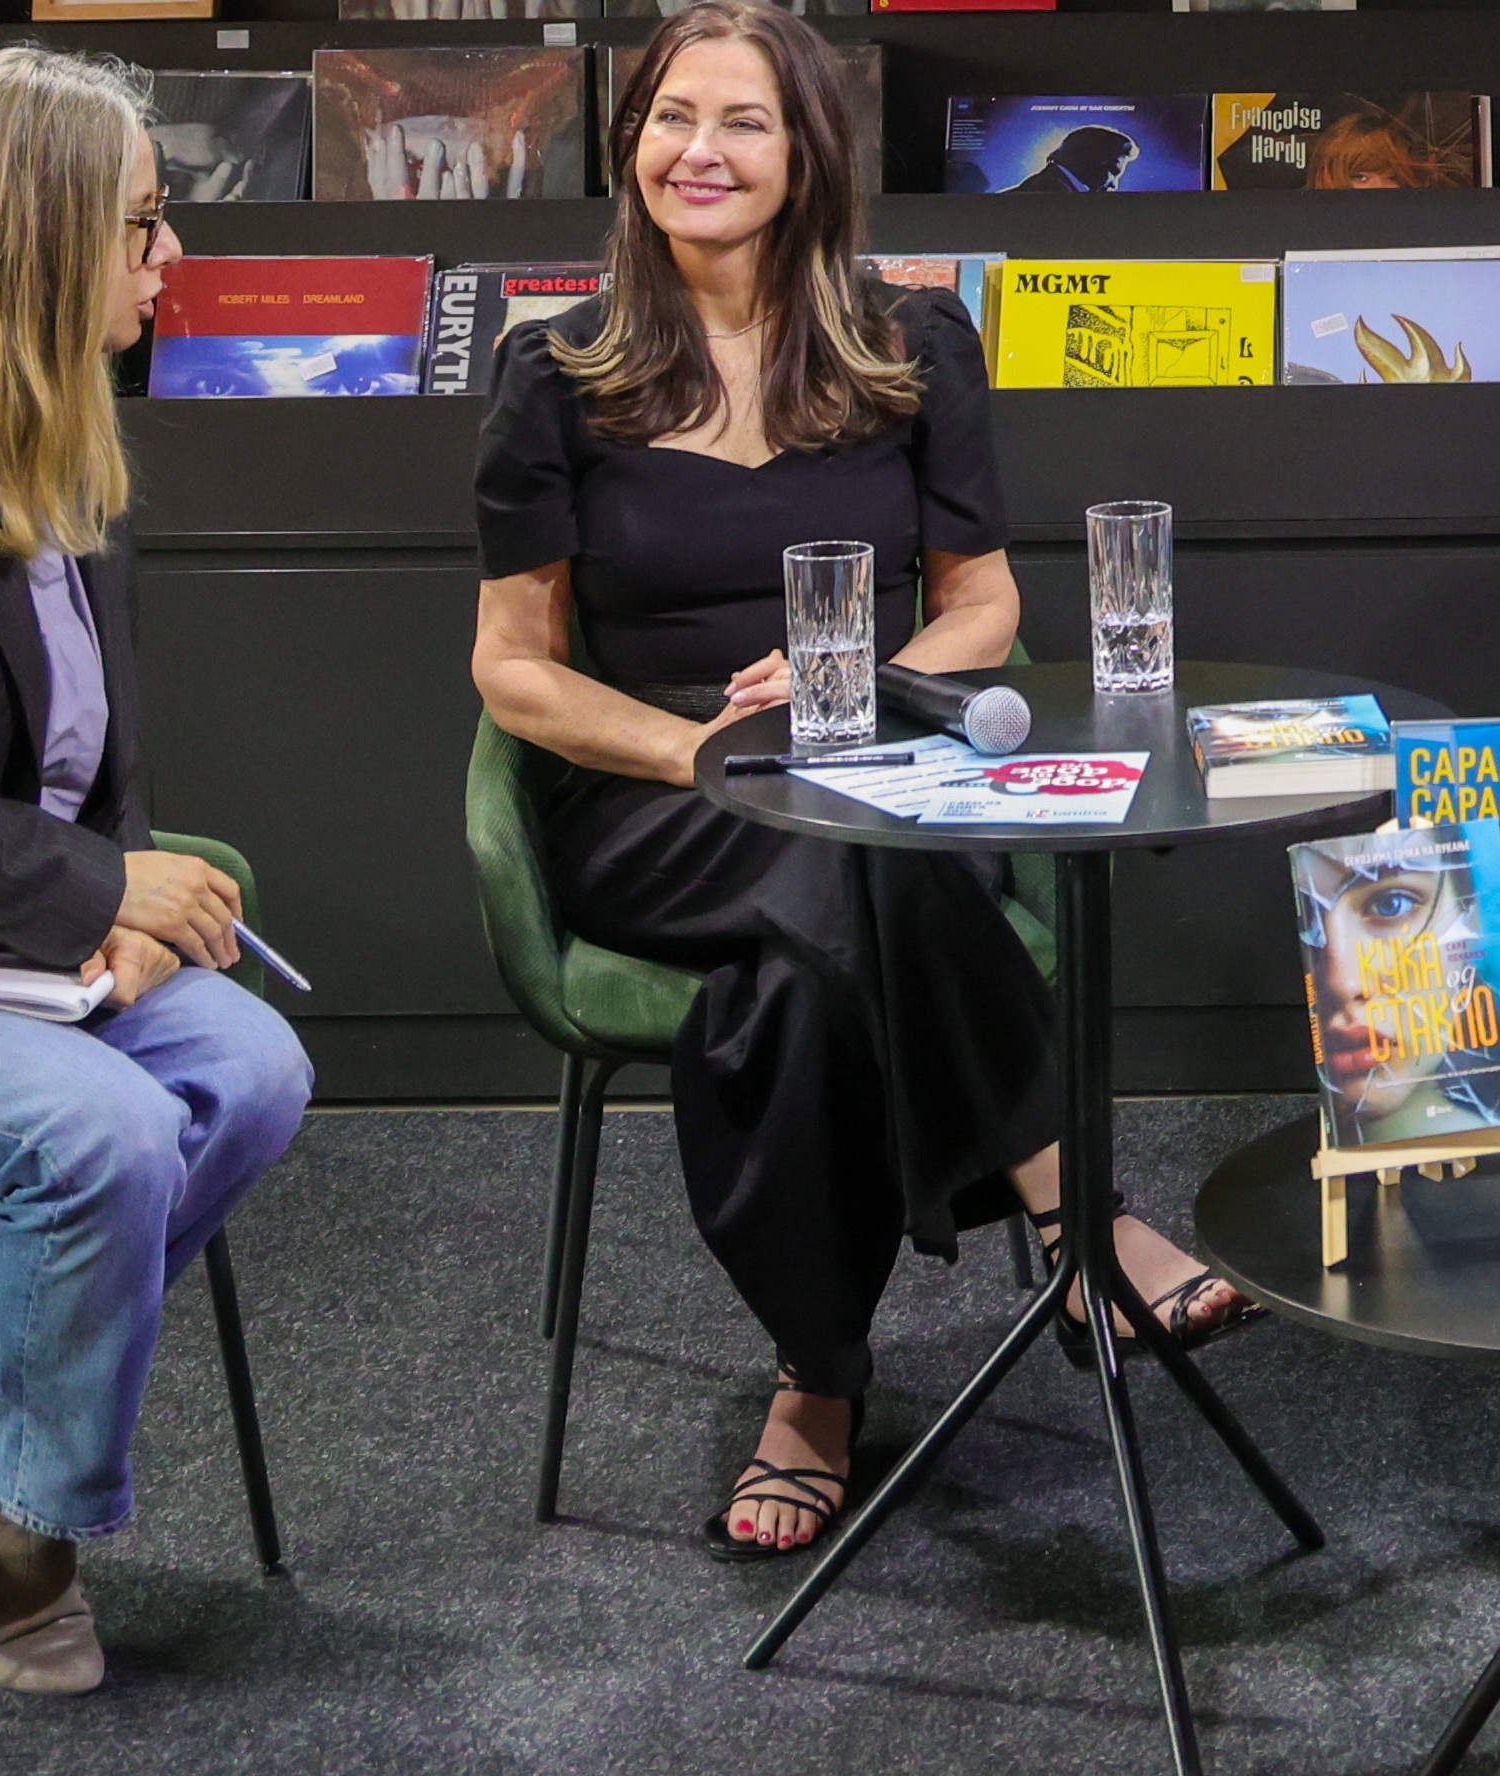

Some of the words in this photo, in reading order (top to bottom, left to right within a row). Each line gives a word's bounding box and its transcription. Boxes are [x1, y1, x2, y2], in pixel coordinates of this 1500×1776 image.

[1231, 102, 1321, 132] Françoise
[1251, 135, 1307, 168] Hardy
[504, 276, 599, 297] greatest
[1014, 274, 1111, 294] MGMT
[1409, 746, 1499, 787] САРА
[1411, 785, 1499, 824] САРА
[1446, 964, 1477, 1013] од
[1365, 984, 1500, 1063] СТАКЛО
